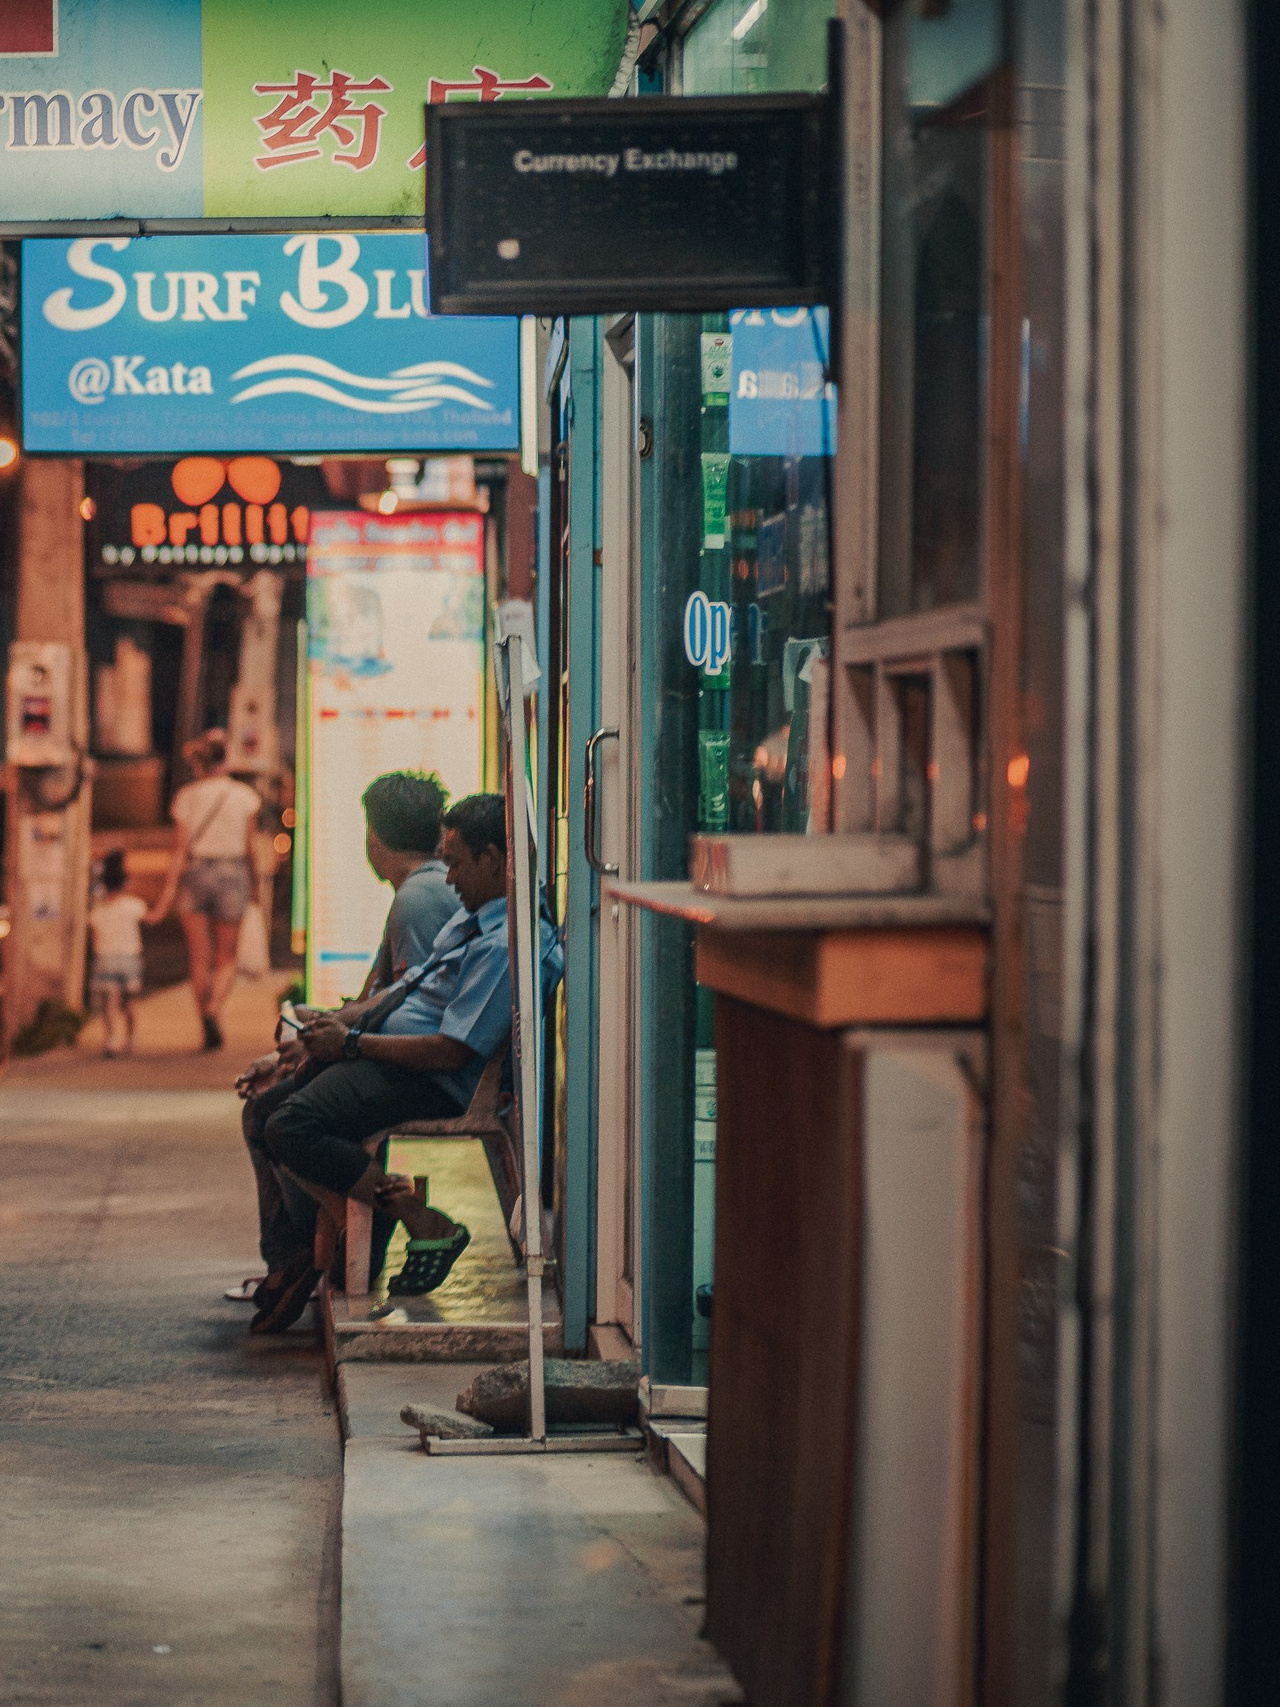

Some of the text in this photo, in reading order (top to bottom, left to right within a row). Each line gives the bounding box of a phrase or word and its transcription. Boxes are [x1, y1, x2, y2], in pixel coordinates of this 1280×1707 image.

[513, 148, 738, 177] Currency Exchange
[42, 237, 261, 331] SURF
[67, 355, 214, 405] @Kata
